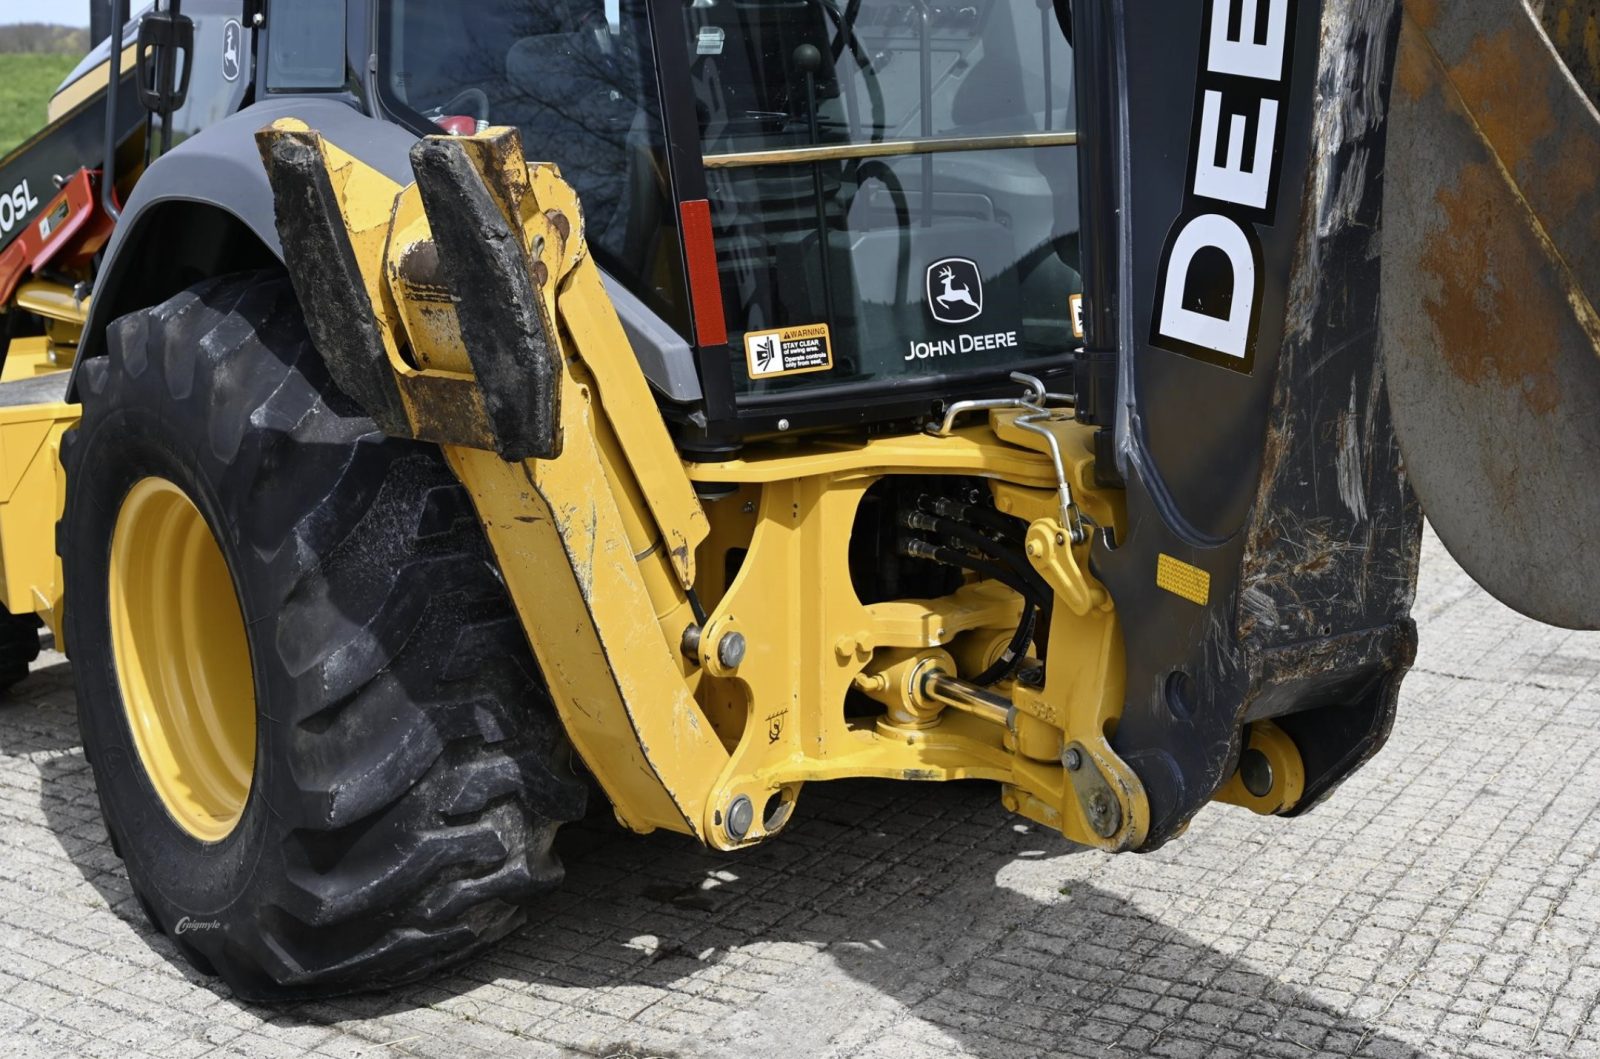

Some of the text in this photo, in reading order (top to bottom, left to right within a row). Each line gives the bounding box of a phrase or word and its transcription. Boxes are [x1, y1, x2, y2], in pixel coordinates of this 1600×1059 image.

[790, 327, 825, 338] WARNING
[904, 331, 1018, 361] JOHN DEERE
